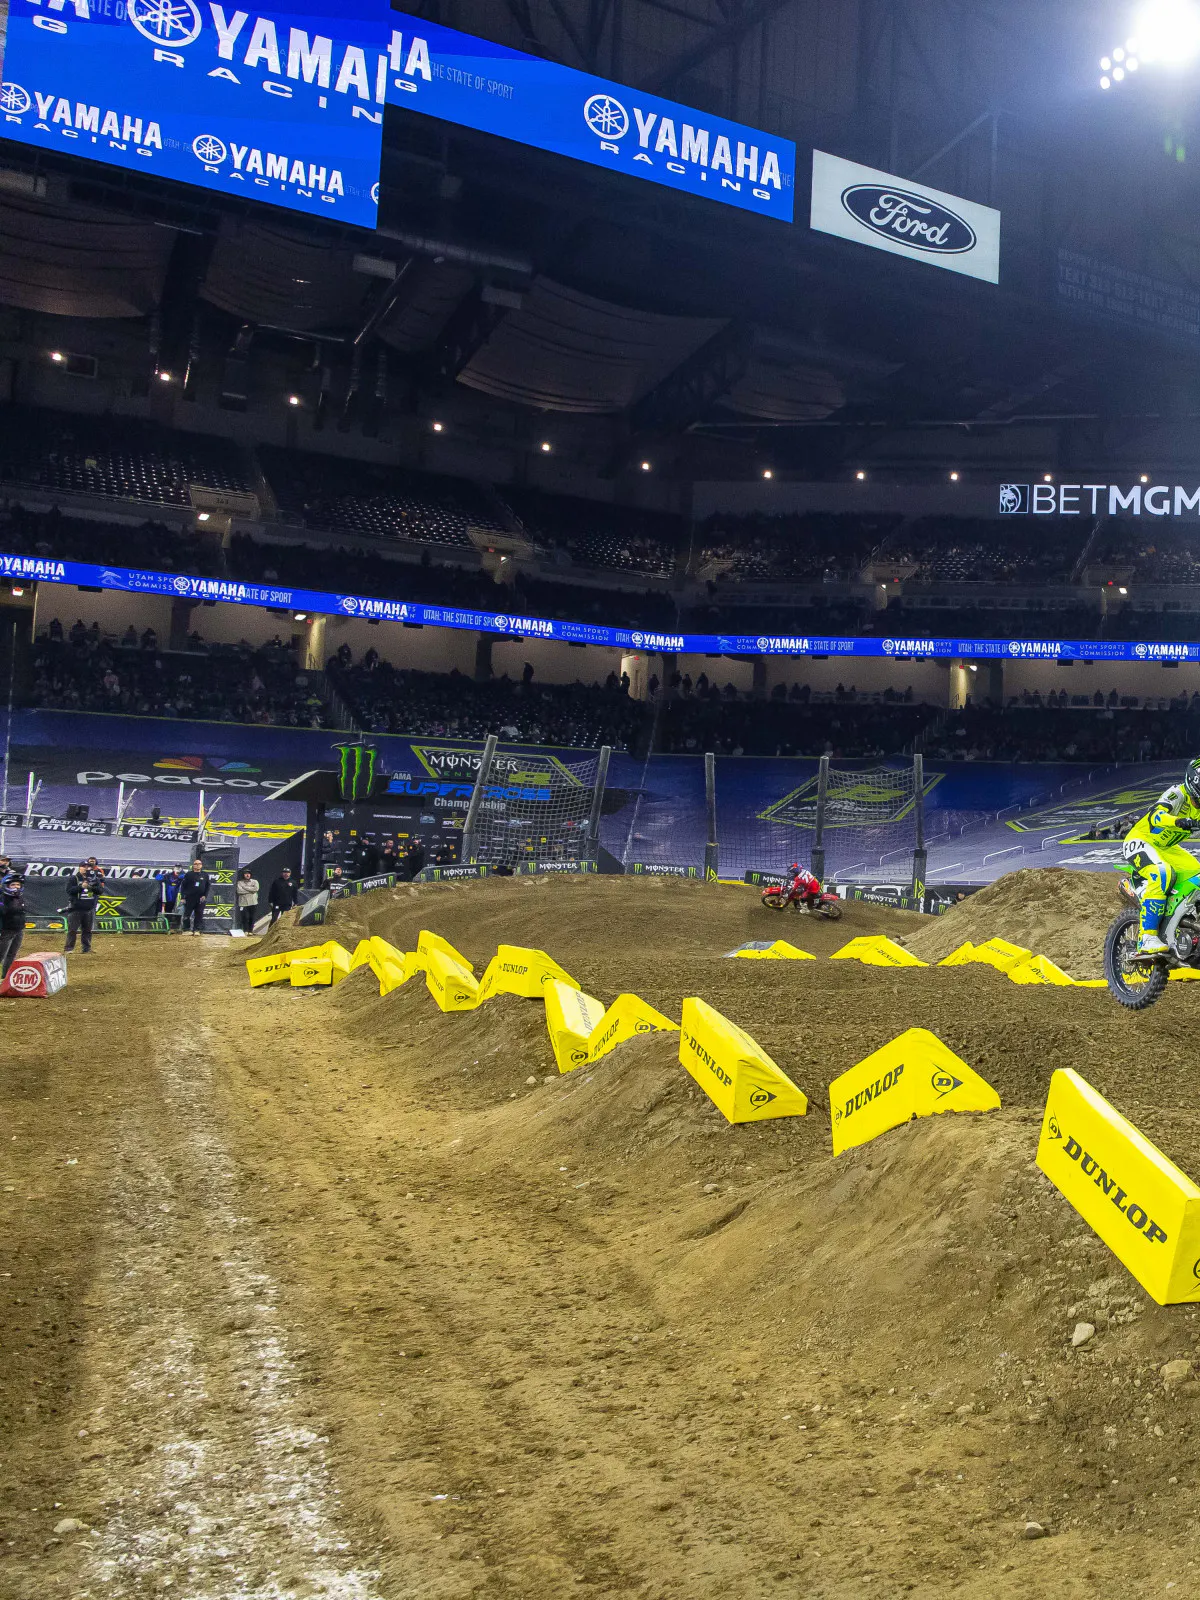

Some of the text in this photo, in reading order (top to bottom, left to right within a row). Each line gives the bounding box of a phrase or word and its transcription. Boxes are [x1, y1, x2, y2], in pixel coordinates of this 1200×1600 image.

[446, 67, 514, 100] STATE OF SPORT
[34, 92, 163, 150] YAMAHA
[5, 115, 153, 157] RACING
[633, 107, 782, 190] YAMAHA
[230, 142, 345, 197] YAMAHA
[600, 141, 771, 200] RACING
[204, 165, 336, 204] RACING
[869, 194, 951, 245] Ford
[4, 557, 65, 576] YAMAHA
[3, 571, 60, 580] ACING
[128, 573, 175, 584] UTAH SPO
[128, 581, 176, 591] COMMISS
[191, 579, 246, 598] YAMAHA
[270, 592, 292, 604] SPORT
[359, 600, 408, 616] YAMAHA
[423, 609, 441, 621] UTAH:
[443, 611, 454, 622] THE
[455, 613, 474, 625] STATE
[474, 615, 482, 626] OF
[483, 616, 496, 627] SPO
[509, 617, 553, 634] YAMAHA
[561, 631, 609, 641] COMMISSION
[583, 627, 610, 635] SPORTS
[644, 634, 684, 648] YAMAHA
[769, 638, 809, 650] YAMAHA
[814, 641, 829, 651] STATE
[838, 641, 855, 651] SPORT
[894, 640, 934, 652] YAMAHA
[974, 643, 985, 653] THE
[985, 644, 1001, 654] STATE
[1020, 642, 1061, 653] YAMAHA
[1148, 644, 1189, 655] YAMAHA
[431, 755, 518, 772] MONSER
[393, 771, 412, 780] AMA
[387, 781, 552, 800] SUPERROSS
[434, 797, 506, 811] Champnship
[443, 867, 477, 876] MONSTER
[645, 865, 685, 873] MONSTER
[864, 893, 898, 904] MONSTER
[263, 962, 291, 973] DUN
[503, 963, 528, 975] DUNLOP
[1031, 967, 1051, 984] DUNL
[593, 1018, 620, 1057] DUNLOP
[689, 1037, 733, 1086] DUNLOP
[845, 1064, 904, 1118] DUNLOP
[1063, 1135, 1168, 1244] DUNLOP
